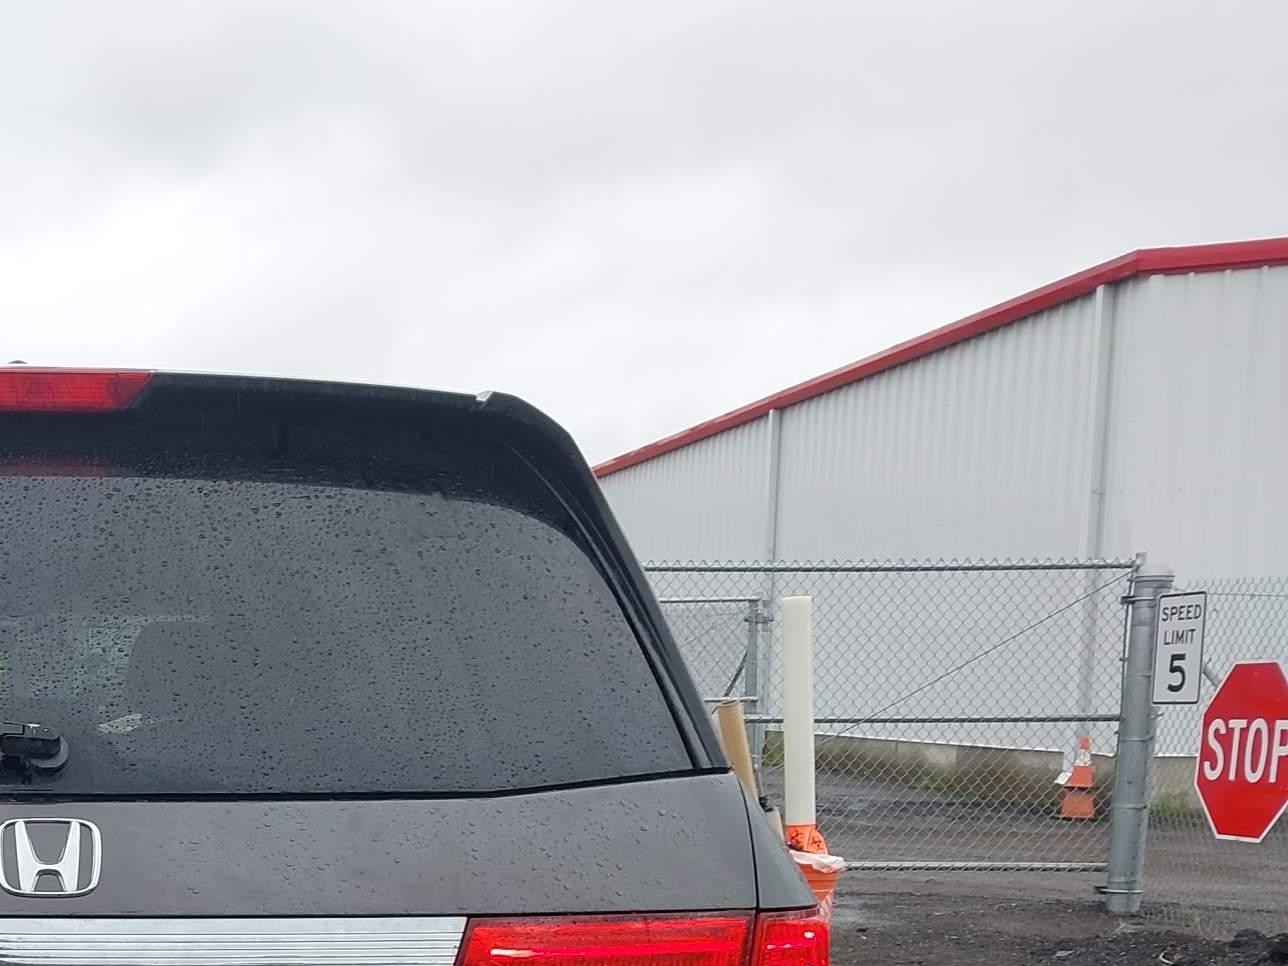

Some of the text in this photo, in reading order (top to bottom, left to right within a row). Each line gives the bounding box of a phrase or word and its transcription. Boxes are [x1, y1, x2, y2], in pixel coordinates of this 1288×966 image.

[1161, 604, 1202, 622] SPEED
[1163, 628, 1197, 646] LIMIT
[1166, 653, 1187, 692] 5
[1203, 718, 1288, 783] STOP
